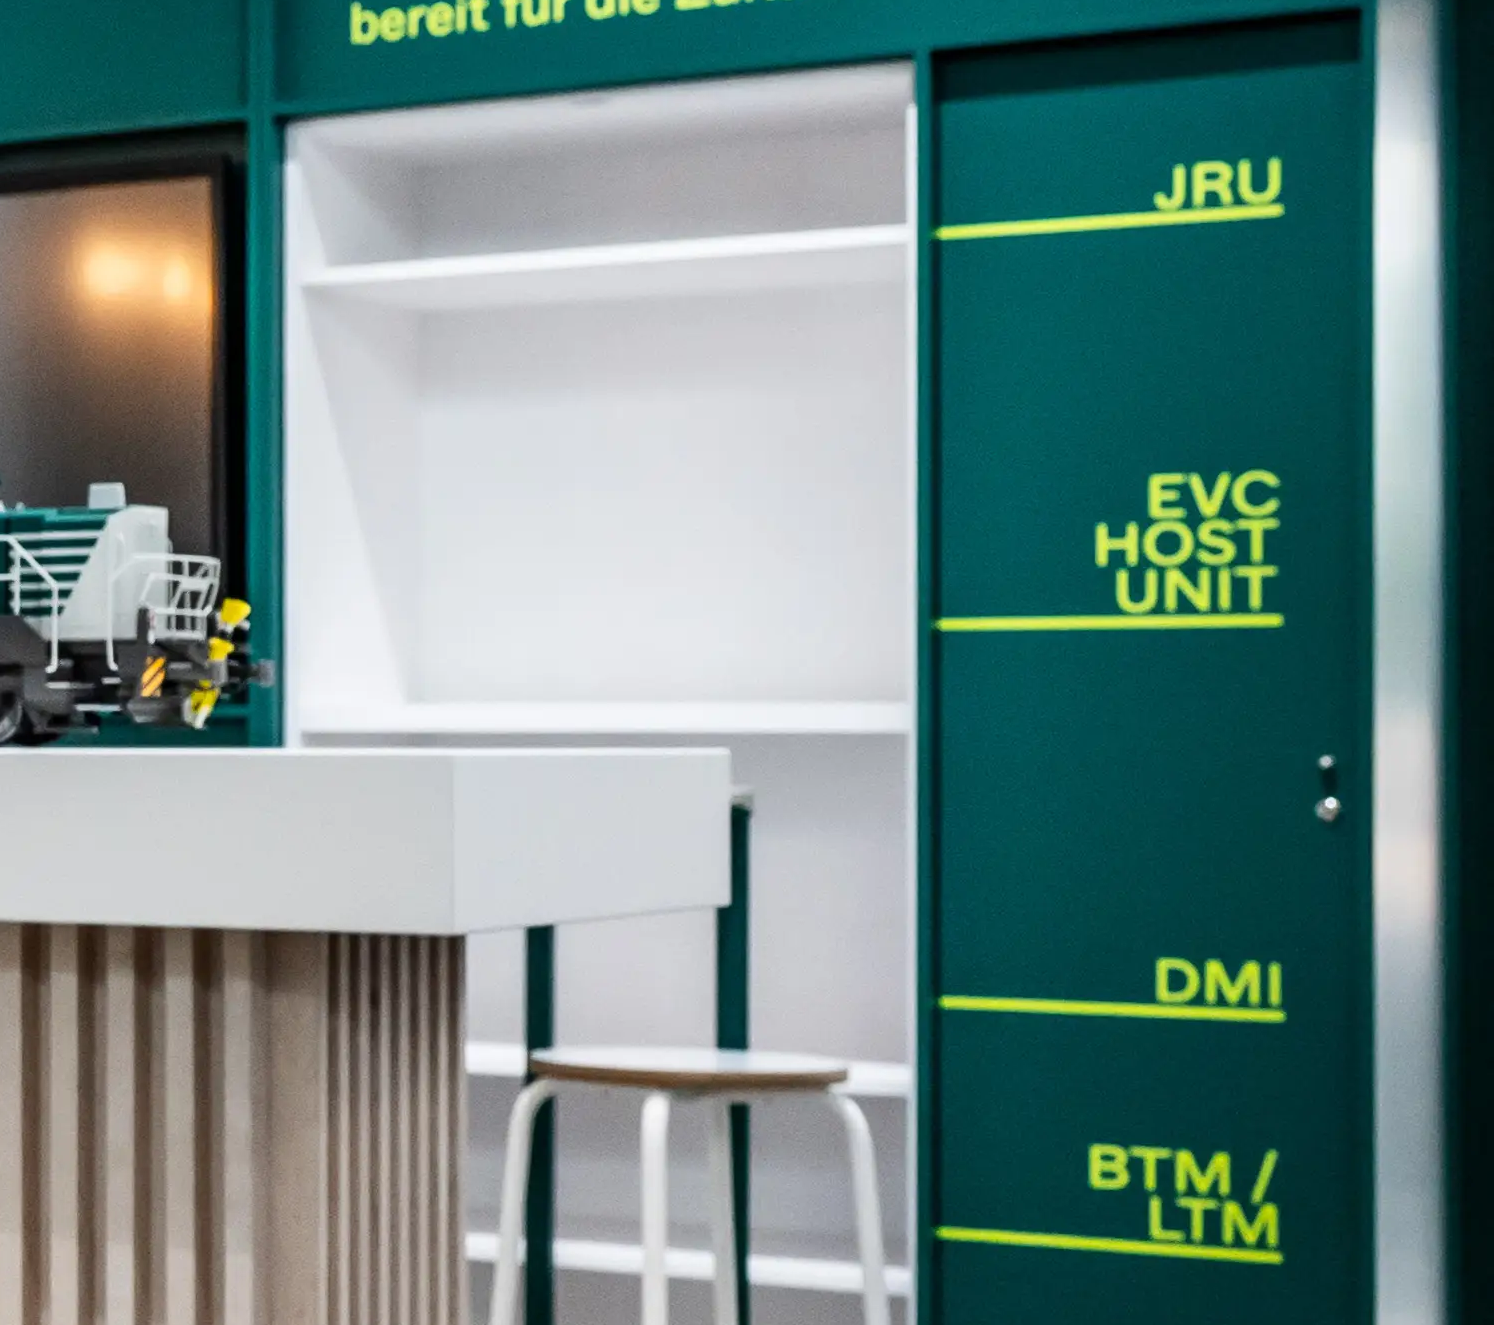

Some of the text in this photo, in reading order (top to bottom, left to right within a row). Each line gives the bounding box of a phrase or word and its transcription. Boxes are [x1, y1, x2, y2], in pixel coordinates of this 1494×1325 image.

[1154, 157, 1283, 211] JRU
[1148, 470, 1280, 520] EVC
[1095, 519, 1279, 567] HOST
[1116, 566, 1277, 614] UNIT
[1156, 958, 1282, 1005] DMI
[1089, 1144, 1277, 1203] BTM /
[1149, 1197, 1278, 1246] LTM
